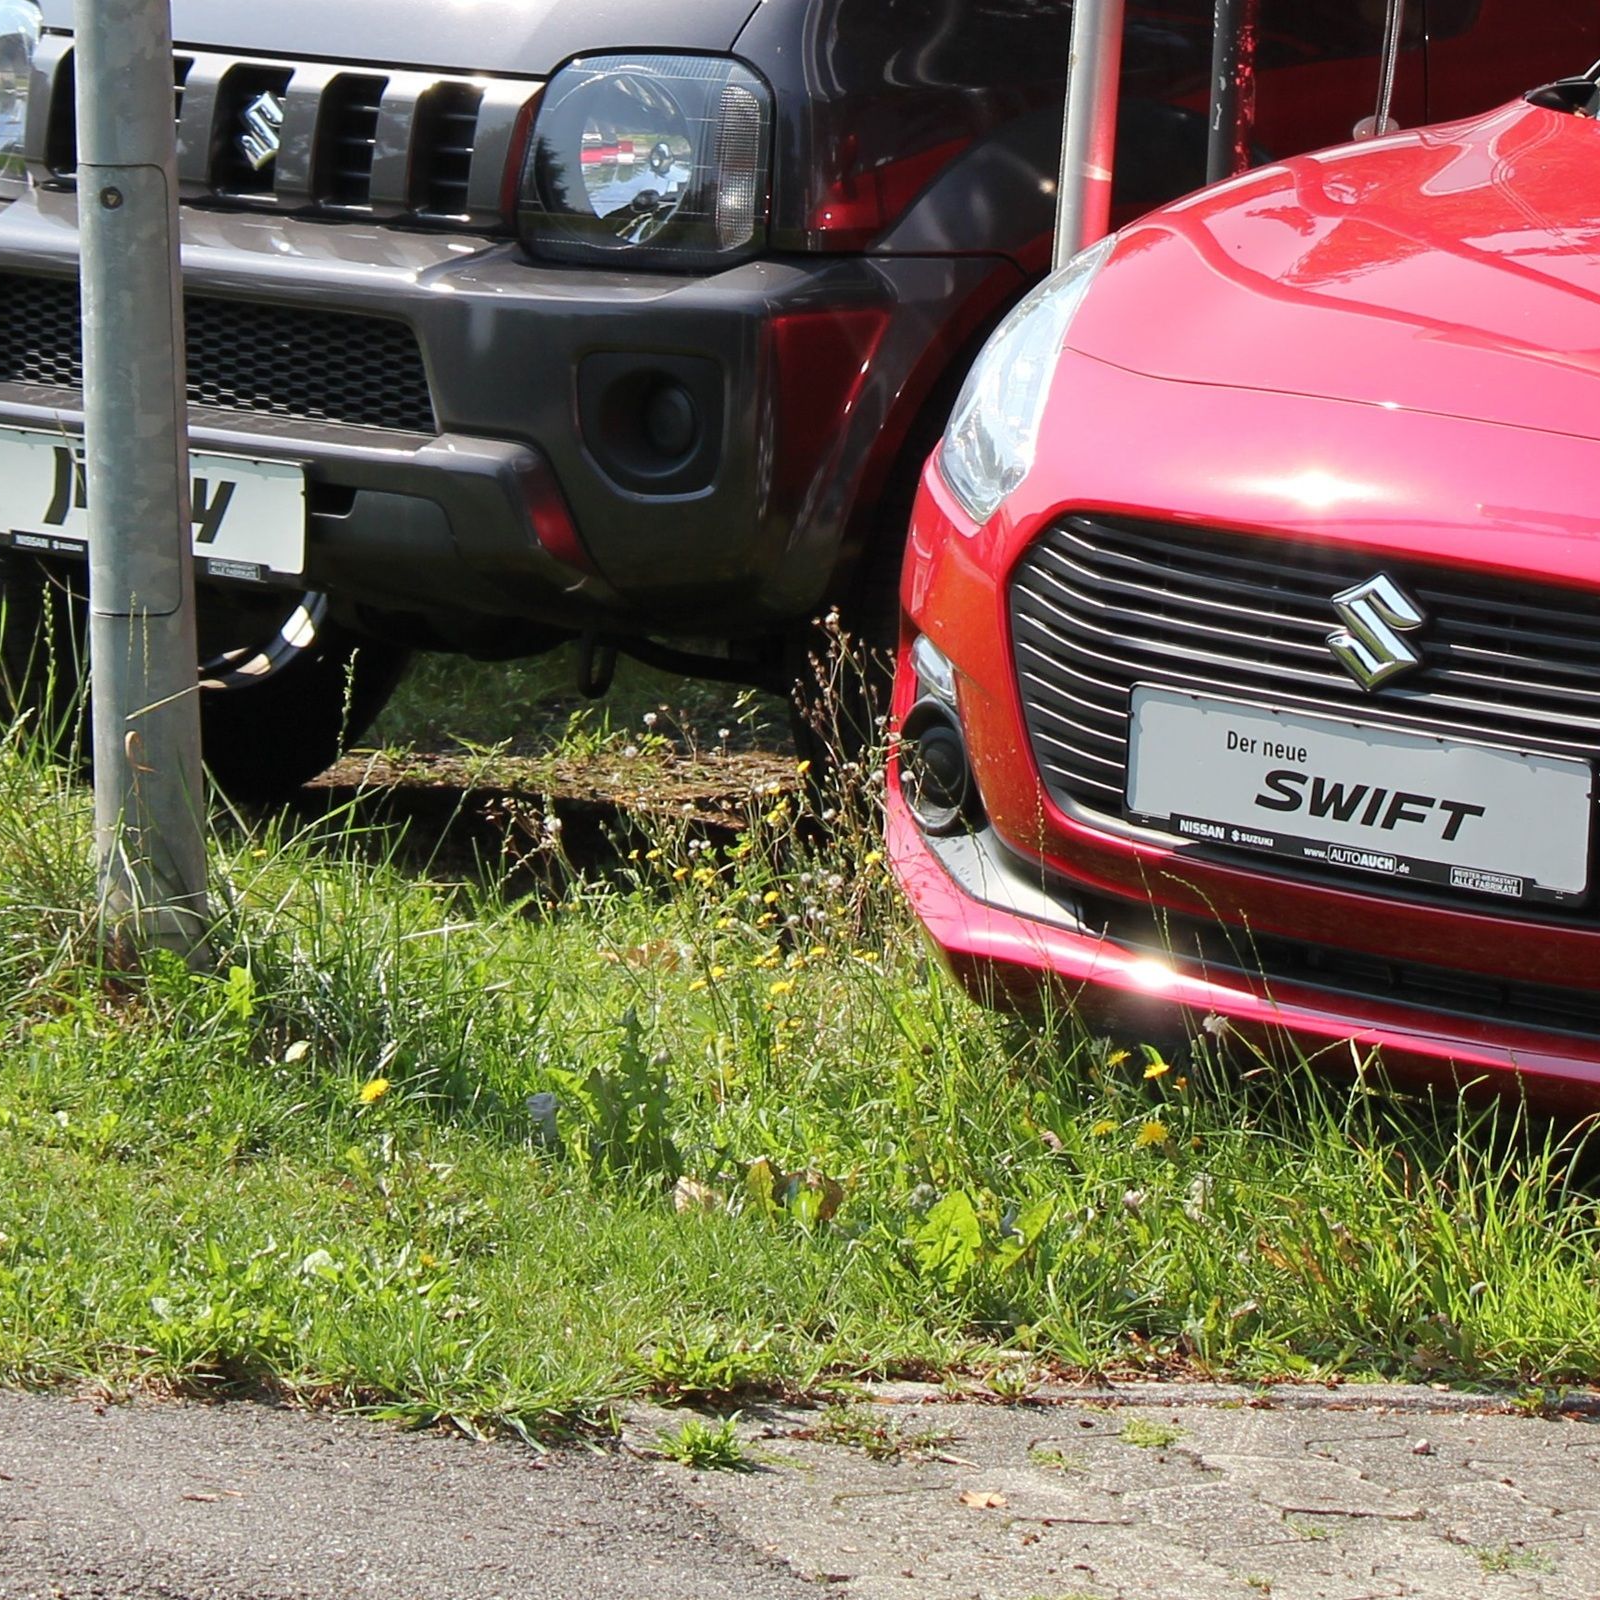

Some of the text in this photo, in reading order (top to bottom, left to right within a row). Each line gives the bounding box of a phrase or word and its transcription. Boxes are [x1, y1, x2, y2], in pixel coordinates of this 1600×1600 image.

[1227, 730, 1308, 763] Der neue
[1253, 769, 1487, 841] SWIFT
[1179, 819, 1274, 847] NISSAN SUZUKI
[1453, 877, 1519, 894] ALLE FABRIKATE
